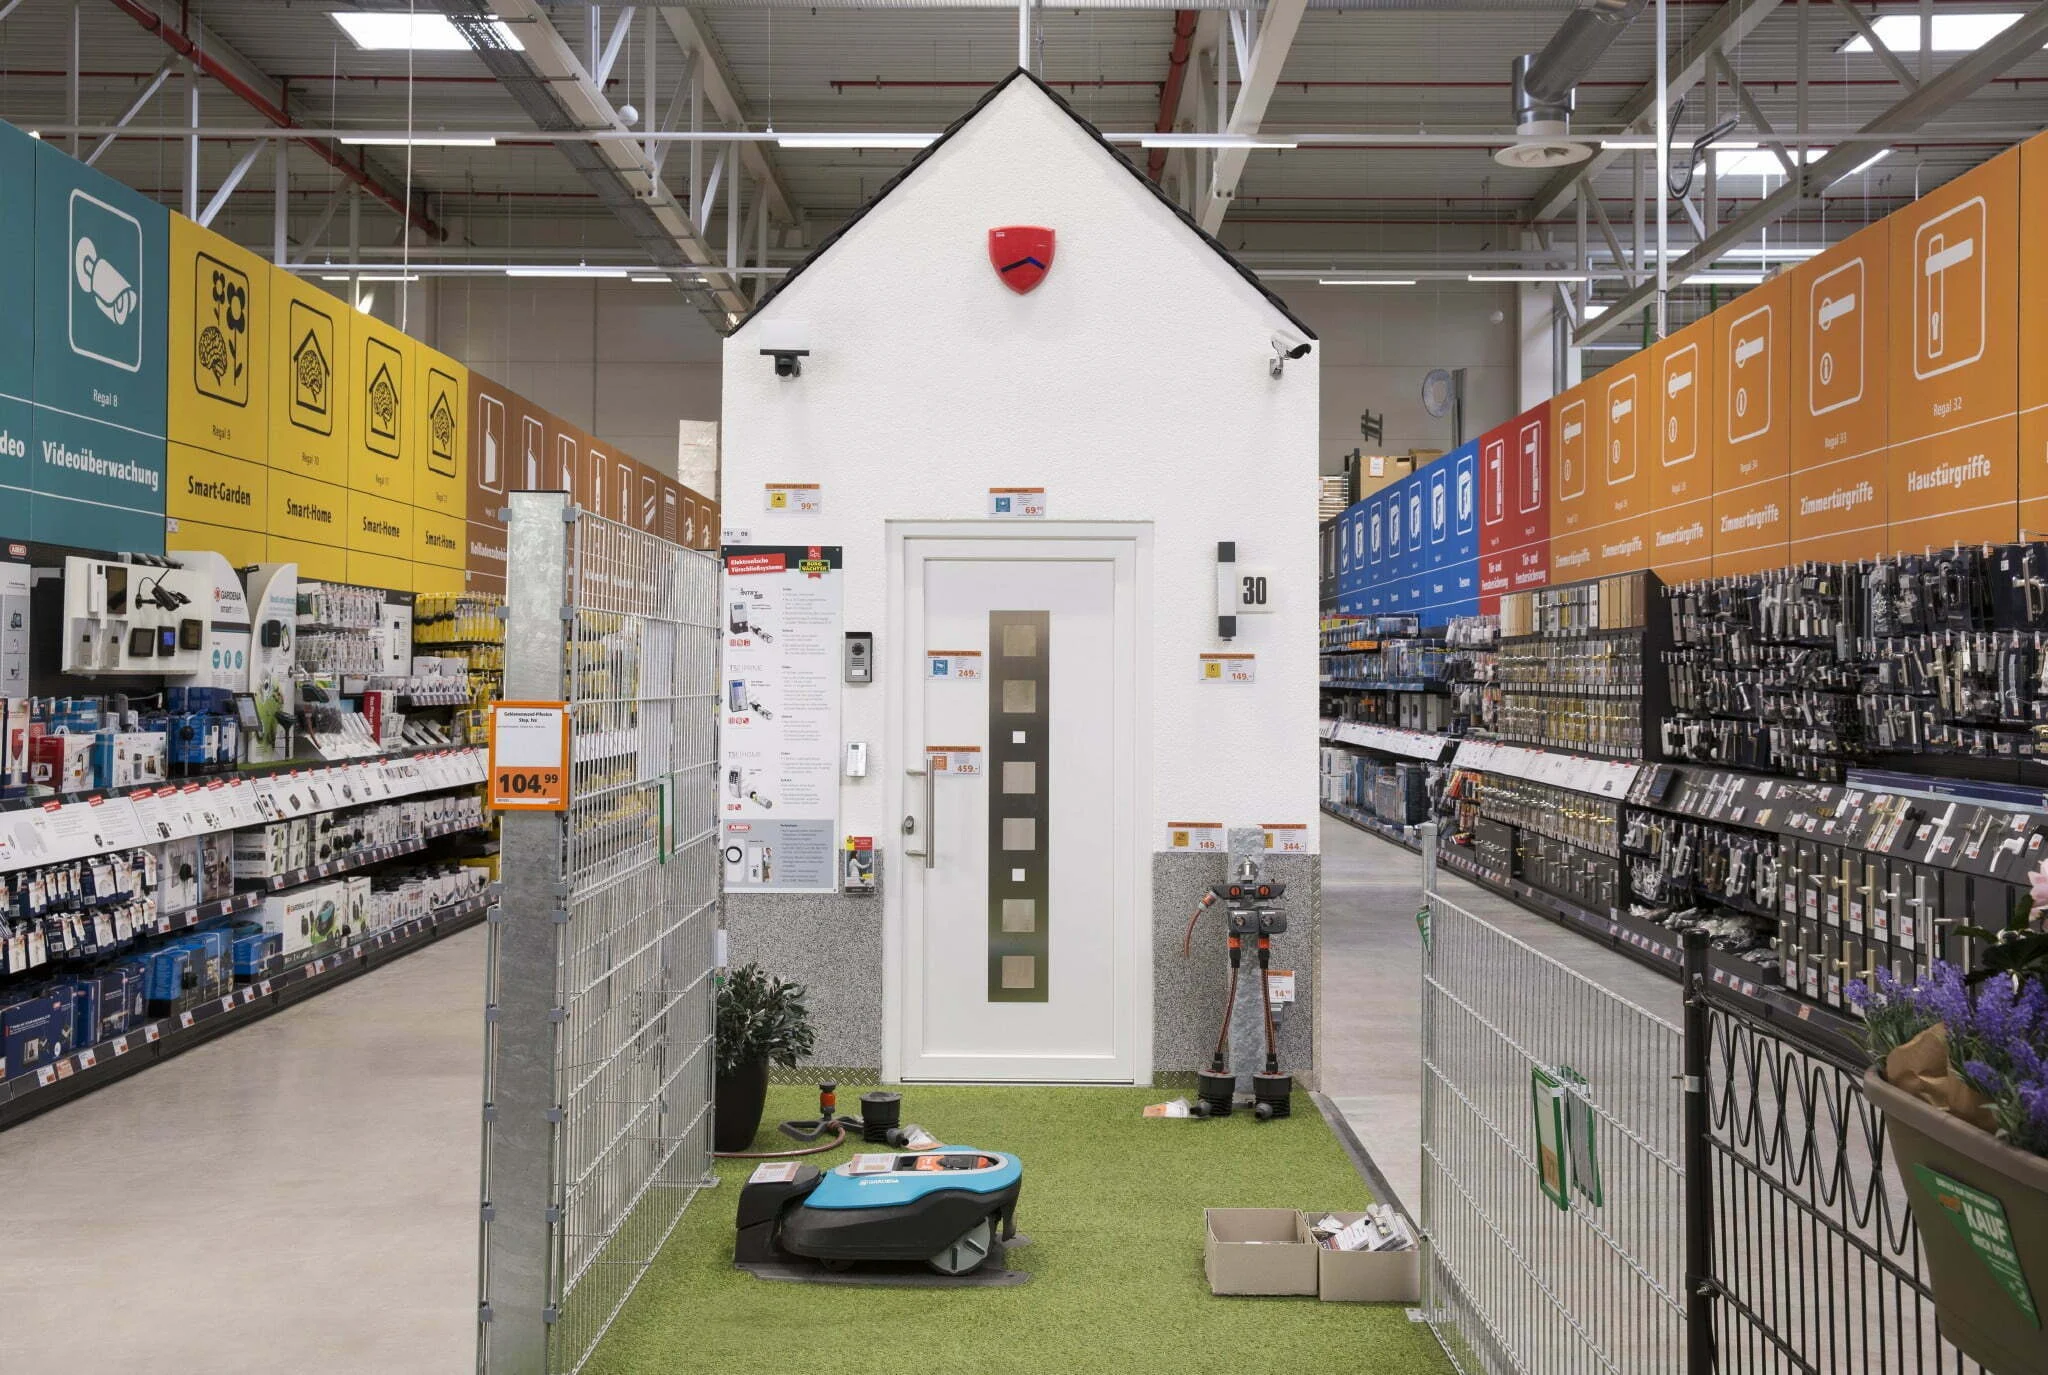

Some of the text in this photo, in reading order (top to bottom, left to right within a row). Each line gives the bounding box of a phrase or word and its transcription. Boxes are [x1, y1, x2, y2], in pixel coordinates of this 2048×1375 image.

[93, 389, 118, 407] Regal 8
[1933, 397, 1963, 418] Regal 32
[212, 424, 225, 440] Regal
[1824, 434, 1838, 450] Regal
[42, 440, 159, 492] Videoüberwachung
[1907, 454, 1991, 493] Haustürgriffe
[188, 475, 251, 507] Smart-Garden
[1800, 481, 1874, 516] Zimmertürgriffe
[286, 498, 332, 524] Smart-Home
[1721, 503, 1780, 533] Zimmertürgriffe
[363, 516, 400, 538] Smart-Home
[1656, 522, 1704, 547] Zimmertürgriffe
[425, 530, 456, 550] Smart-Home
[220, 590, 241, 601] GARDENA
[1243, 576, 1267, 605] 30
